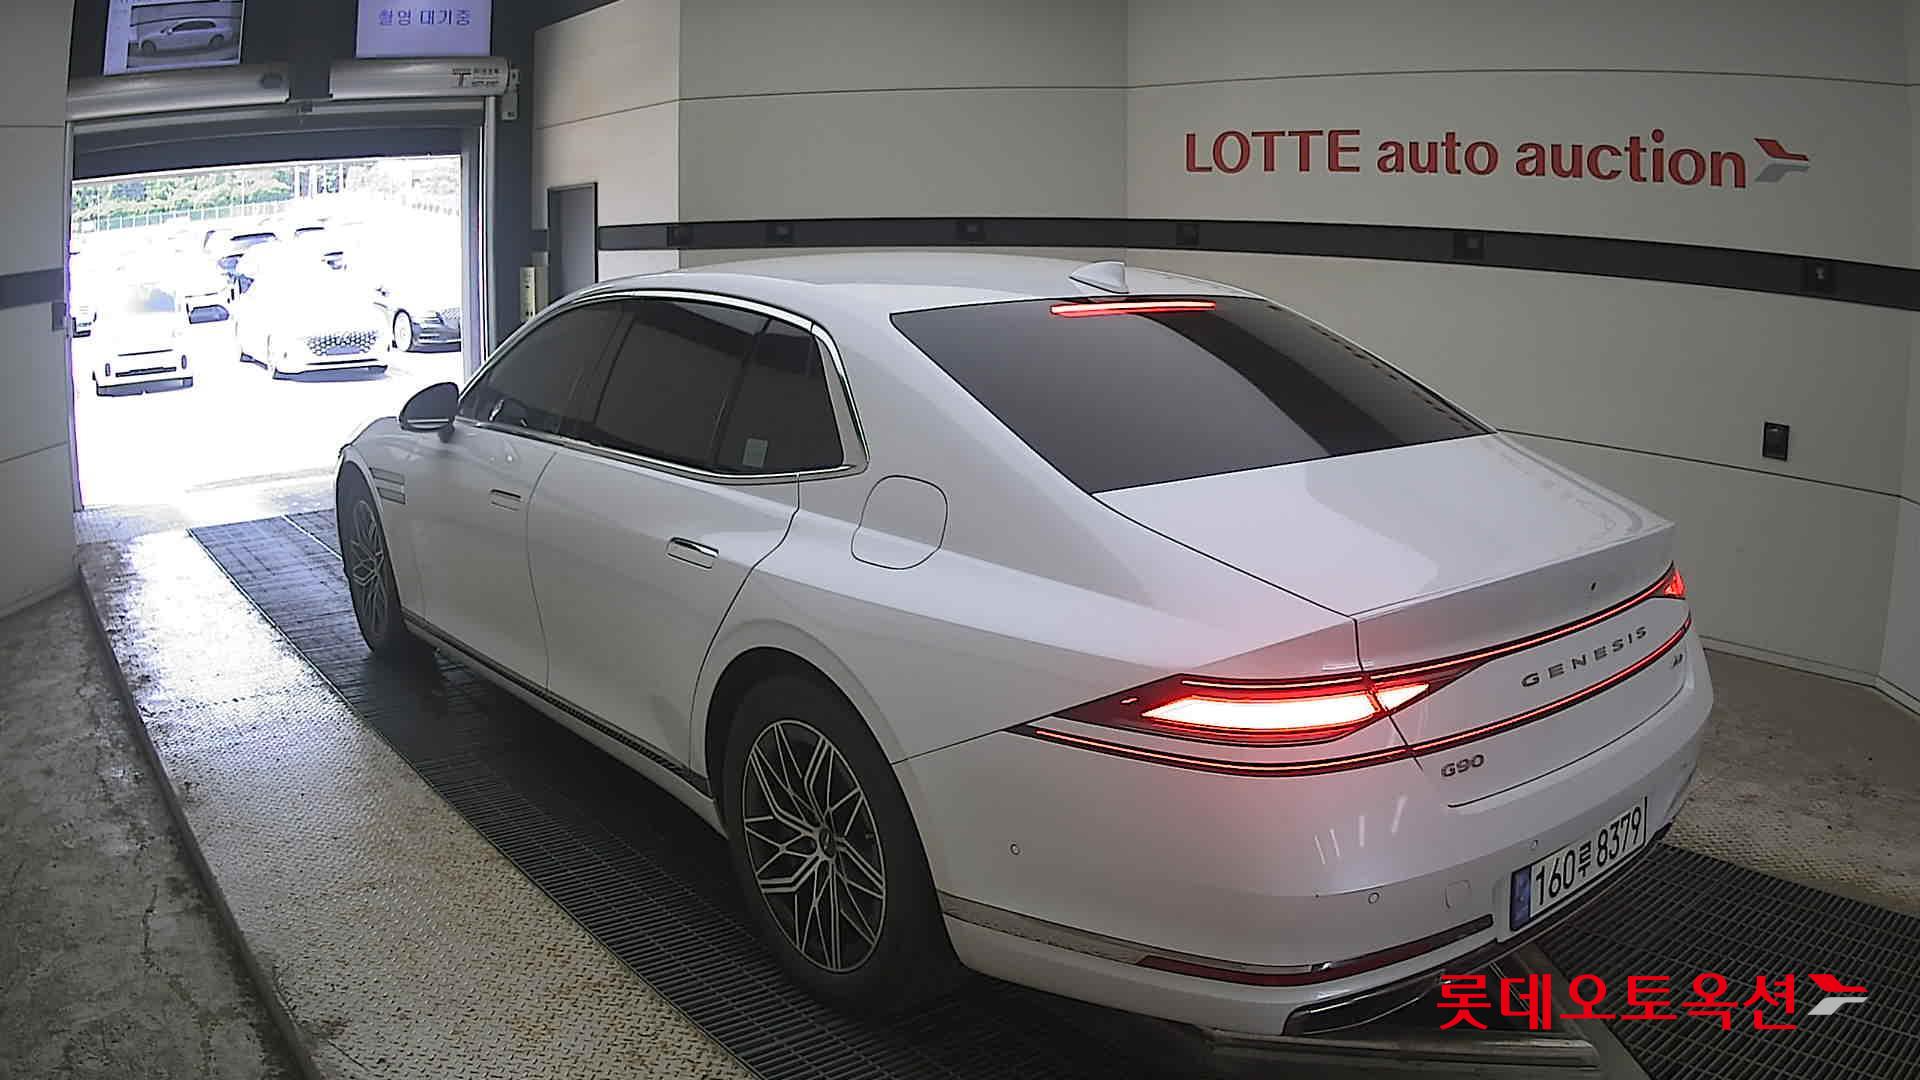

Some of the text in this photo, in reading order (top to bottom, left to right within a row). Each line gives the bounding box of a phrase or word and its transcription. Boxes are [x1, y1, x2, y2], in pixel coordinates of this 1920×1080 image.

[420, 8, 472, 26] 대기중
[1186, 129, 1747, 189] LOTTE auto auction
[1521, 626, 1647, 687] GENESIS
[1441, 754, 1484, 777] G90
